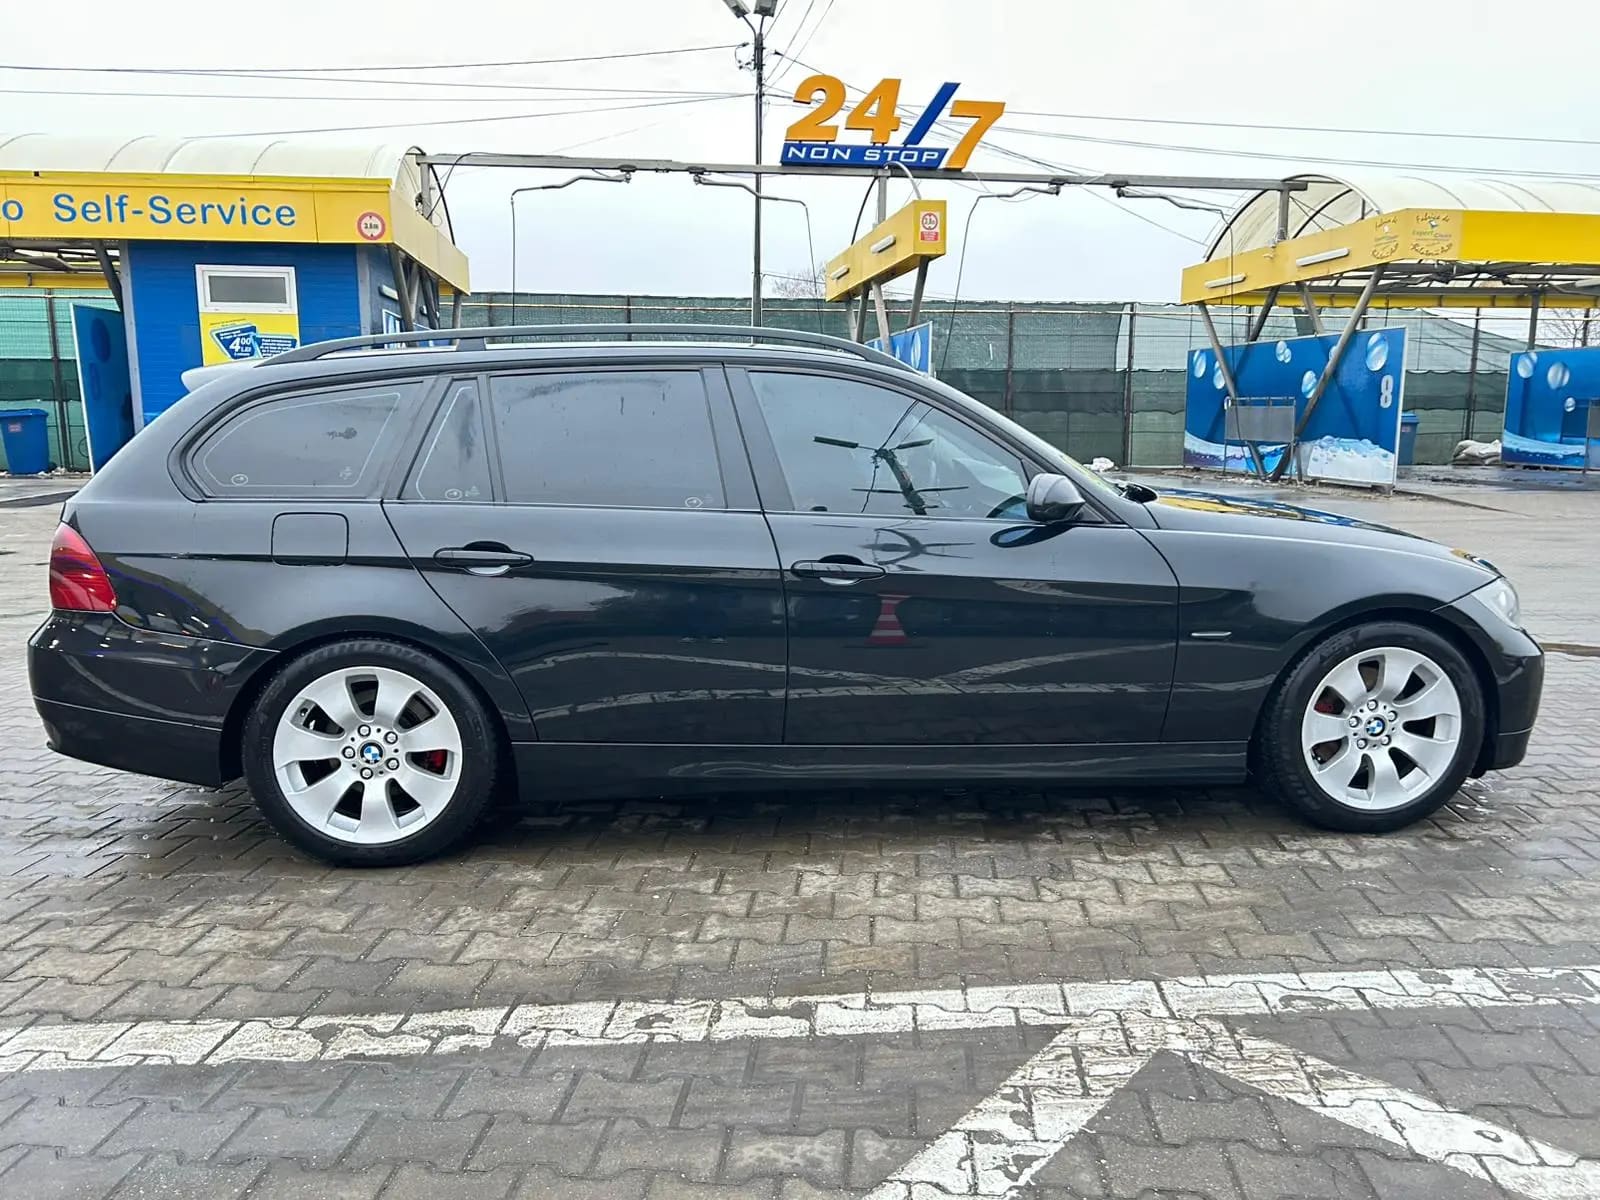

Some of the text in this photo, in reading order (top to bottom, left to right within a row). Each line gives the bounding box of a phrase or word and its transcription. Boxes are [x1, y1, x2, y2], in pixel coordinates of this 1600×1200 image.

[785, 75, 1006, 171] 24/7
[788, 147, 939, 163] NON STOP
[53, 193, 296, 226] Self-Service
[1380, 374, 1394, 409] 8
